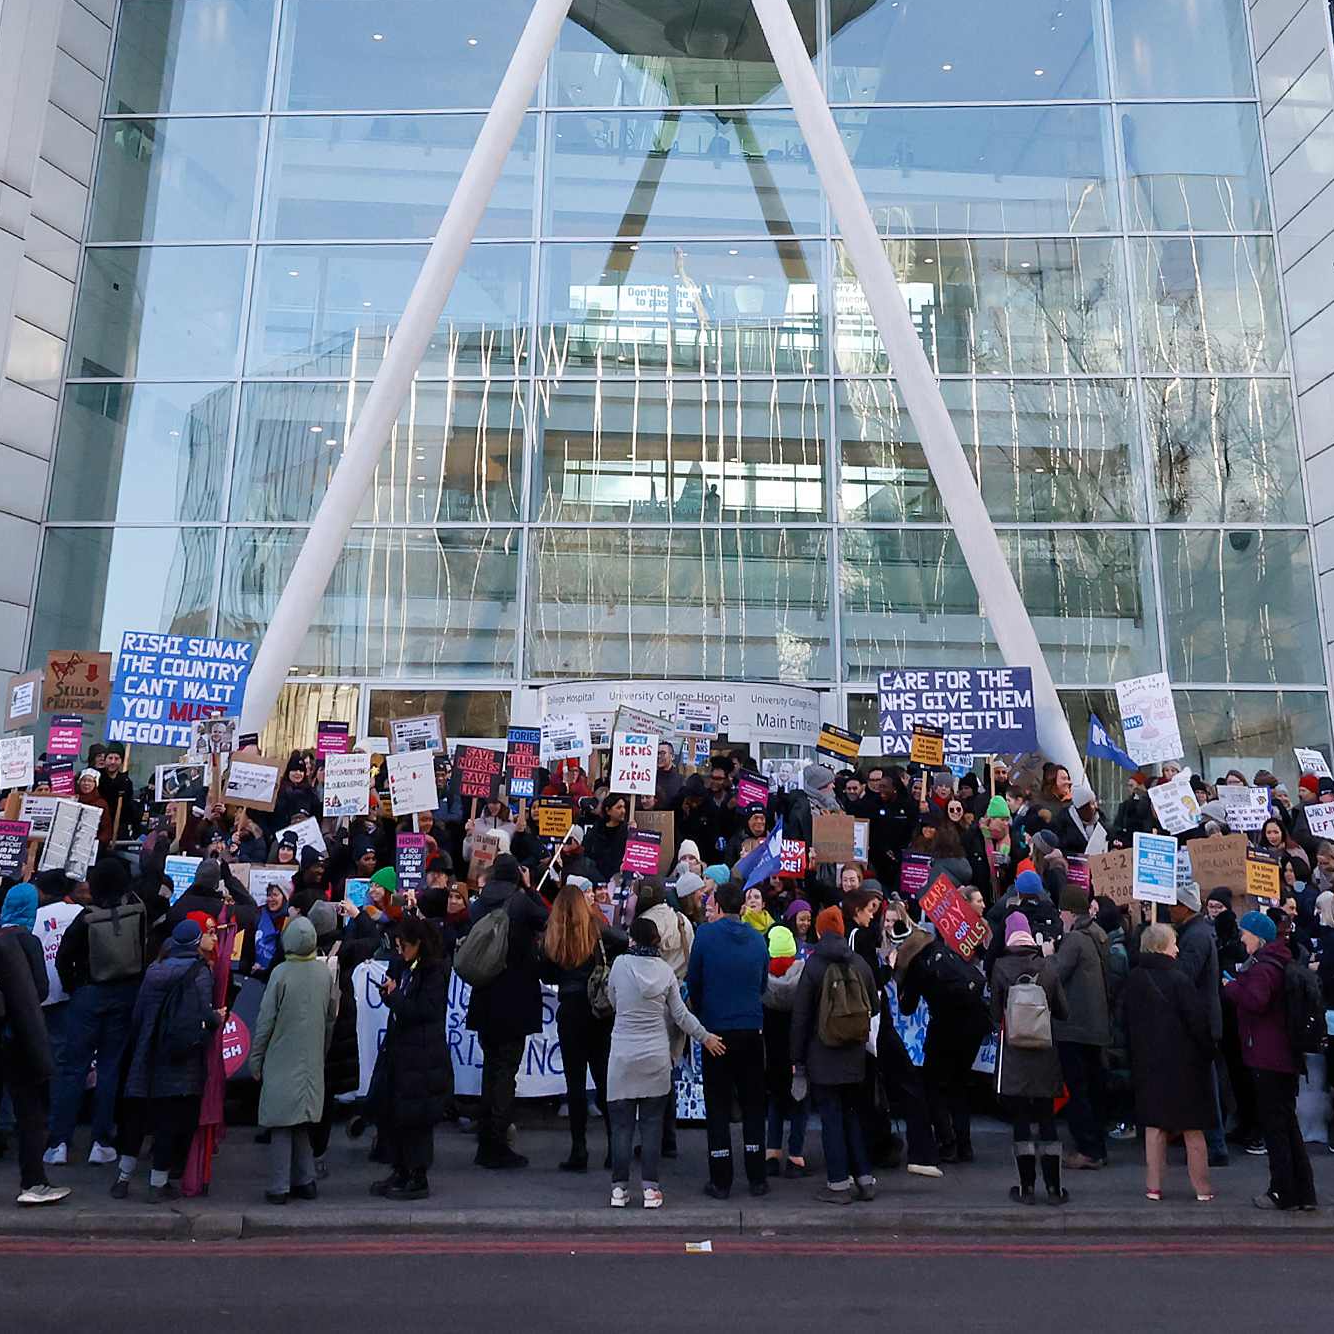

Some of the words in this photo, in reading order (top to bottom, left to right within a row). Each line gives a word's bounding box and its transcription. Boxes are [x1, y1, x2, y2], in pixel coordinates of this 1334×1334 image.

[122, 632, 181, 654] RISHI
[187, 638, 251, 661] SUNAK
[121, 654, 156, 674] THE
[161, 658, 245, 681] COUNTRY
[879, 671, 930, 691] CARE
[935, 670, 971, 689] FOR
[977, 670, 1013, 688] THE
[124, 676, 178, 697] CAN'T
[183, 681, 235, 703] WAIT
[609, 691, 653, 702] University
[657, 691, 694, 701] College
[697, 692, 735, 702] Hospital
[566, 692, 595, 704] Hospital
[751, 695, 787, 707] University
[880, 692, 916, 711] NHS
[922, 692, 973, 710] GIVE
[978, 690, 1032, 708] THEM
[121, 697, 163, 719] YOU
[757, 713, 787, 729] Main
[883, 715, 896, 731] A
[902, 712, 1022, 730] RESPECTFUL
[1123, 716, 1142, 728] NHS
[109, 720, 190, 747] NEGOTI
[508, 730, 540, 742] TORIES
[515, 743, 534, 754] ARE
[881, 735, 913, 754] PAY
[466, 747, 495, 760] SAVE
[507, 755, 540, 766] KILLING
[458, 758, 500, 774] NURSES
[513, 767, 532, 778] THE
[460, 773, 491, 785] SAVE
[510, 779, 534, 794] NHS
[1306, 806, 1323, 818] WHO
[1311, 819, 1334, 832] LEFT
[923, 882, 947, 911] CLAPS
[940, 902, 967, 932] PAY
[959, 921, 987, 956] BILLS
